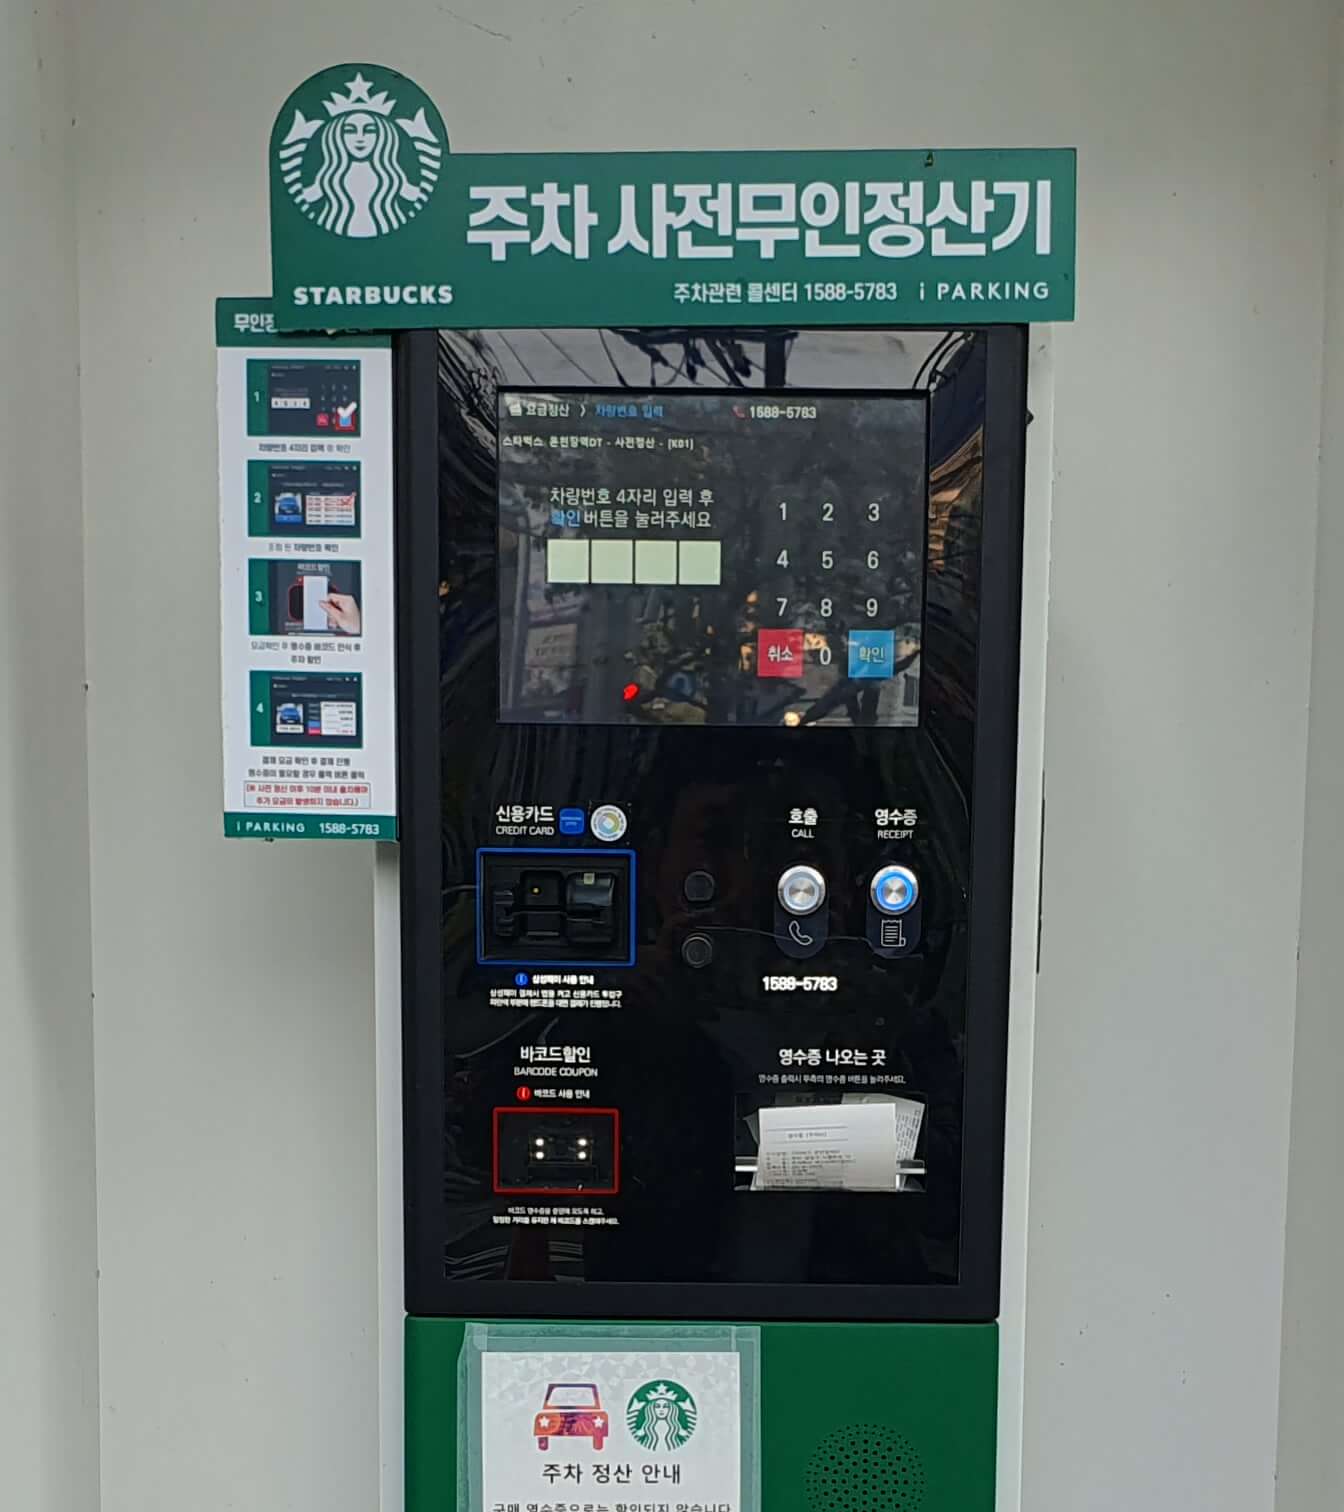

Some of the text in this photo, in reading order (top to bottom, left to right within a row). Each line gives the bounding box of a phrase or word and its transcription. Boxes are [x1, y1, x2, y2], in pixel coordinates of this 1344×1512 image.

[467, 180, 1051, 260] 주차 사전무인정산기
[294, 285, 452, 305] STARBUCKS
[674, 283, 741, 303] 주차관련
[748, 282, 797, 302] 콜센터
[804, 283, 897, 300] 1588-5783
[938, 282, 1048, 300] PARKING
[750, 406, 816, 418] 1588-5783
[254, 492, 261, 503] 2
[550, 488, 714, 506] 차량번호 4자리 입력 후
[584, 508, 628, 527] 버튼을
[635, 511, 711, 528] 눌러주세요
[780, 503, 881, 521] 1 2 3
[777, 550, 878, 569] 4 5 6
[256, 591, 262, 601] 3
[777, 598, 877, 616] 7 8 9
[768, 647, 884, 665] 취소 0 확인
[256, 703, 263, 712] 4
[496, 806, 554, 823] 신용카드
[789, 808, 818, 825] 호출
[875, 809, 917, 826] 영수증
[246, 822, 305, 832] PARKING
[320, 823, 379, 835] 1588-5783
[496, 826, 554, 835] CREDIT CARD
[792, 829, 814, 838] CALL
[878, 830, 913, 839] RECEIPT
[763, 976, 837, 991] 1588-5783
[521, 1046, 590, 1063] 바코드할인
[779, 1049, 886, 1065] 영수증 나오는 곳
[514, 1067, 598, 1076] BARCODE COUPON
[543, 1464, 680, 1484] 주차 정산 안내
